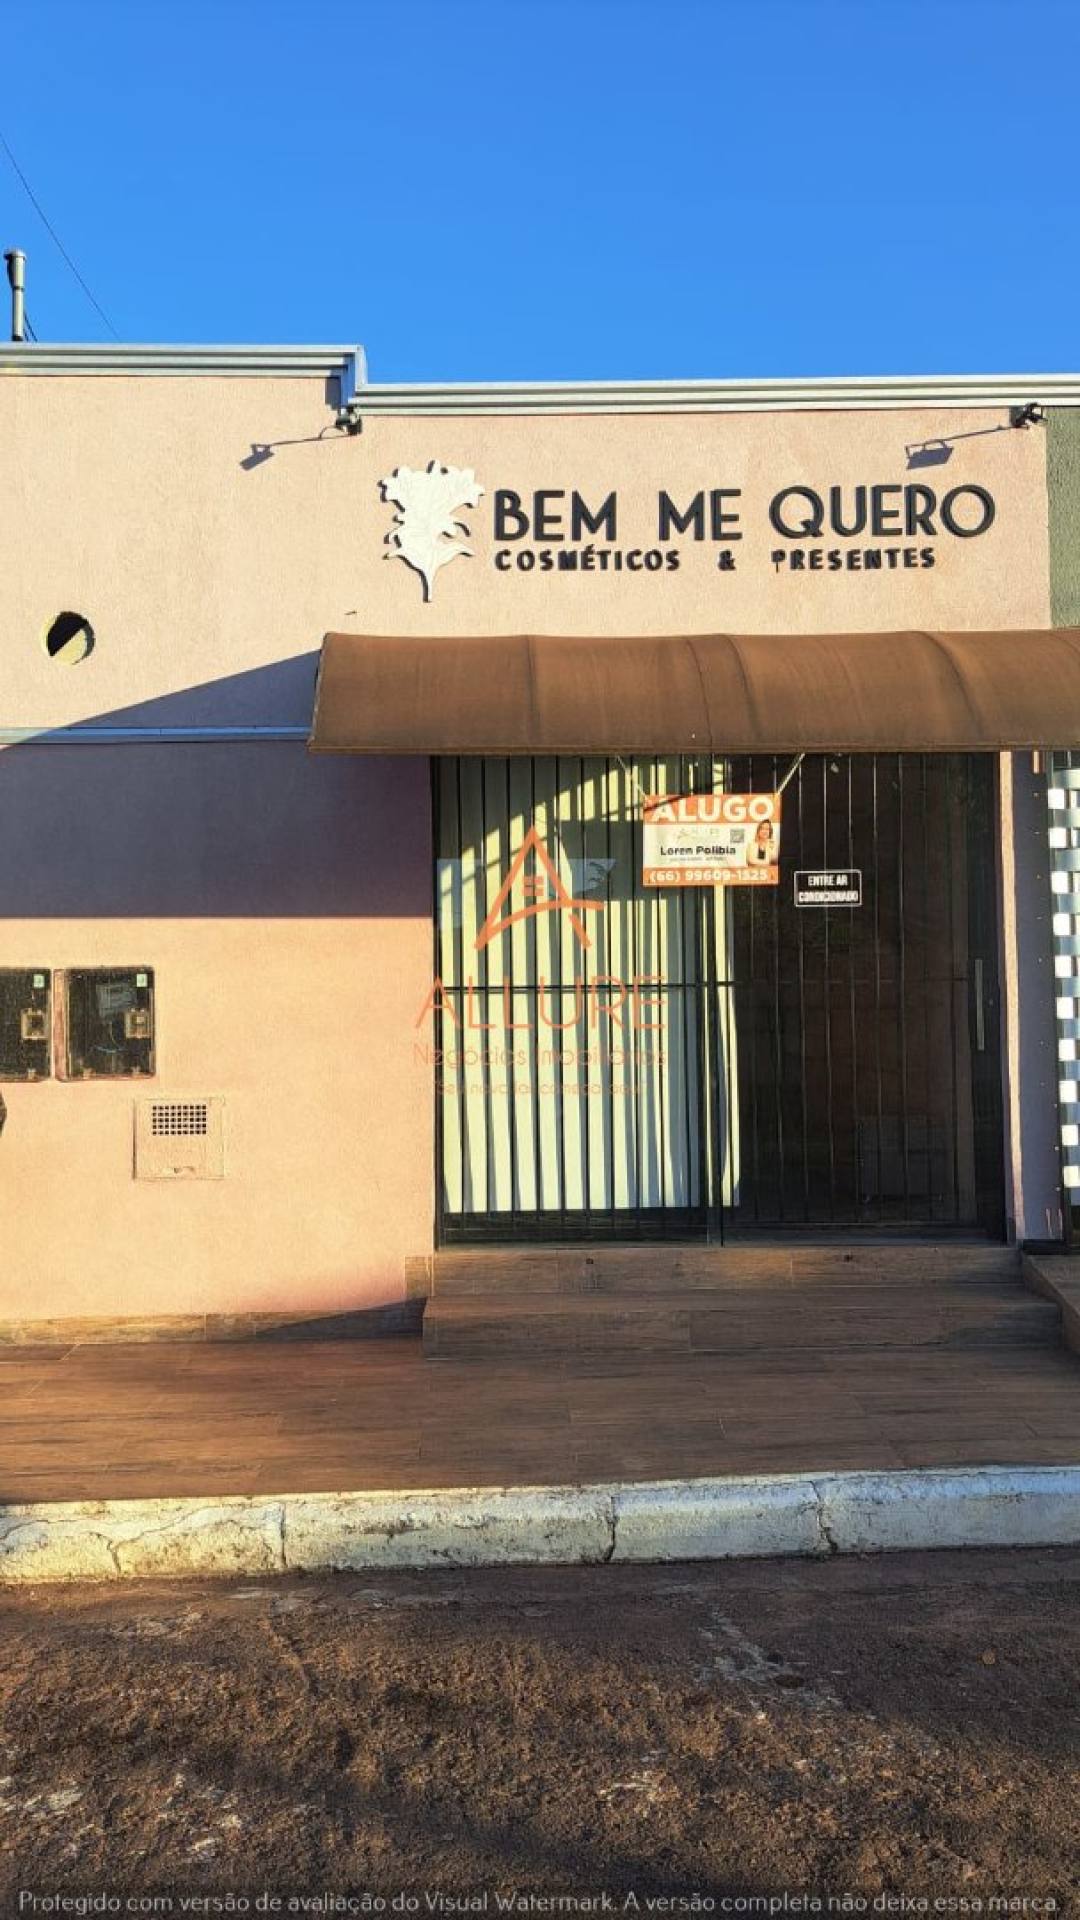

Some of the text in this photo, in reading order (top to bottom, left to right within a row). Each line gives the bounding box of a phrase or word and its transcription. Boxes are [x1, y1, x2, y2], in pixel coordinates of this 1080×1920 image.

[494, 484, 996, 542] BEM ME QUERO
[495, 544, 936, 573] COSMÉTICOS & PRESENTES
[651, 796, 774, 822] ALUGO
[649, 869, 681, 883] (66)
[807, 874, 849, 886] ENTRE AR
